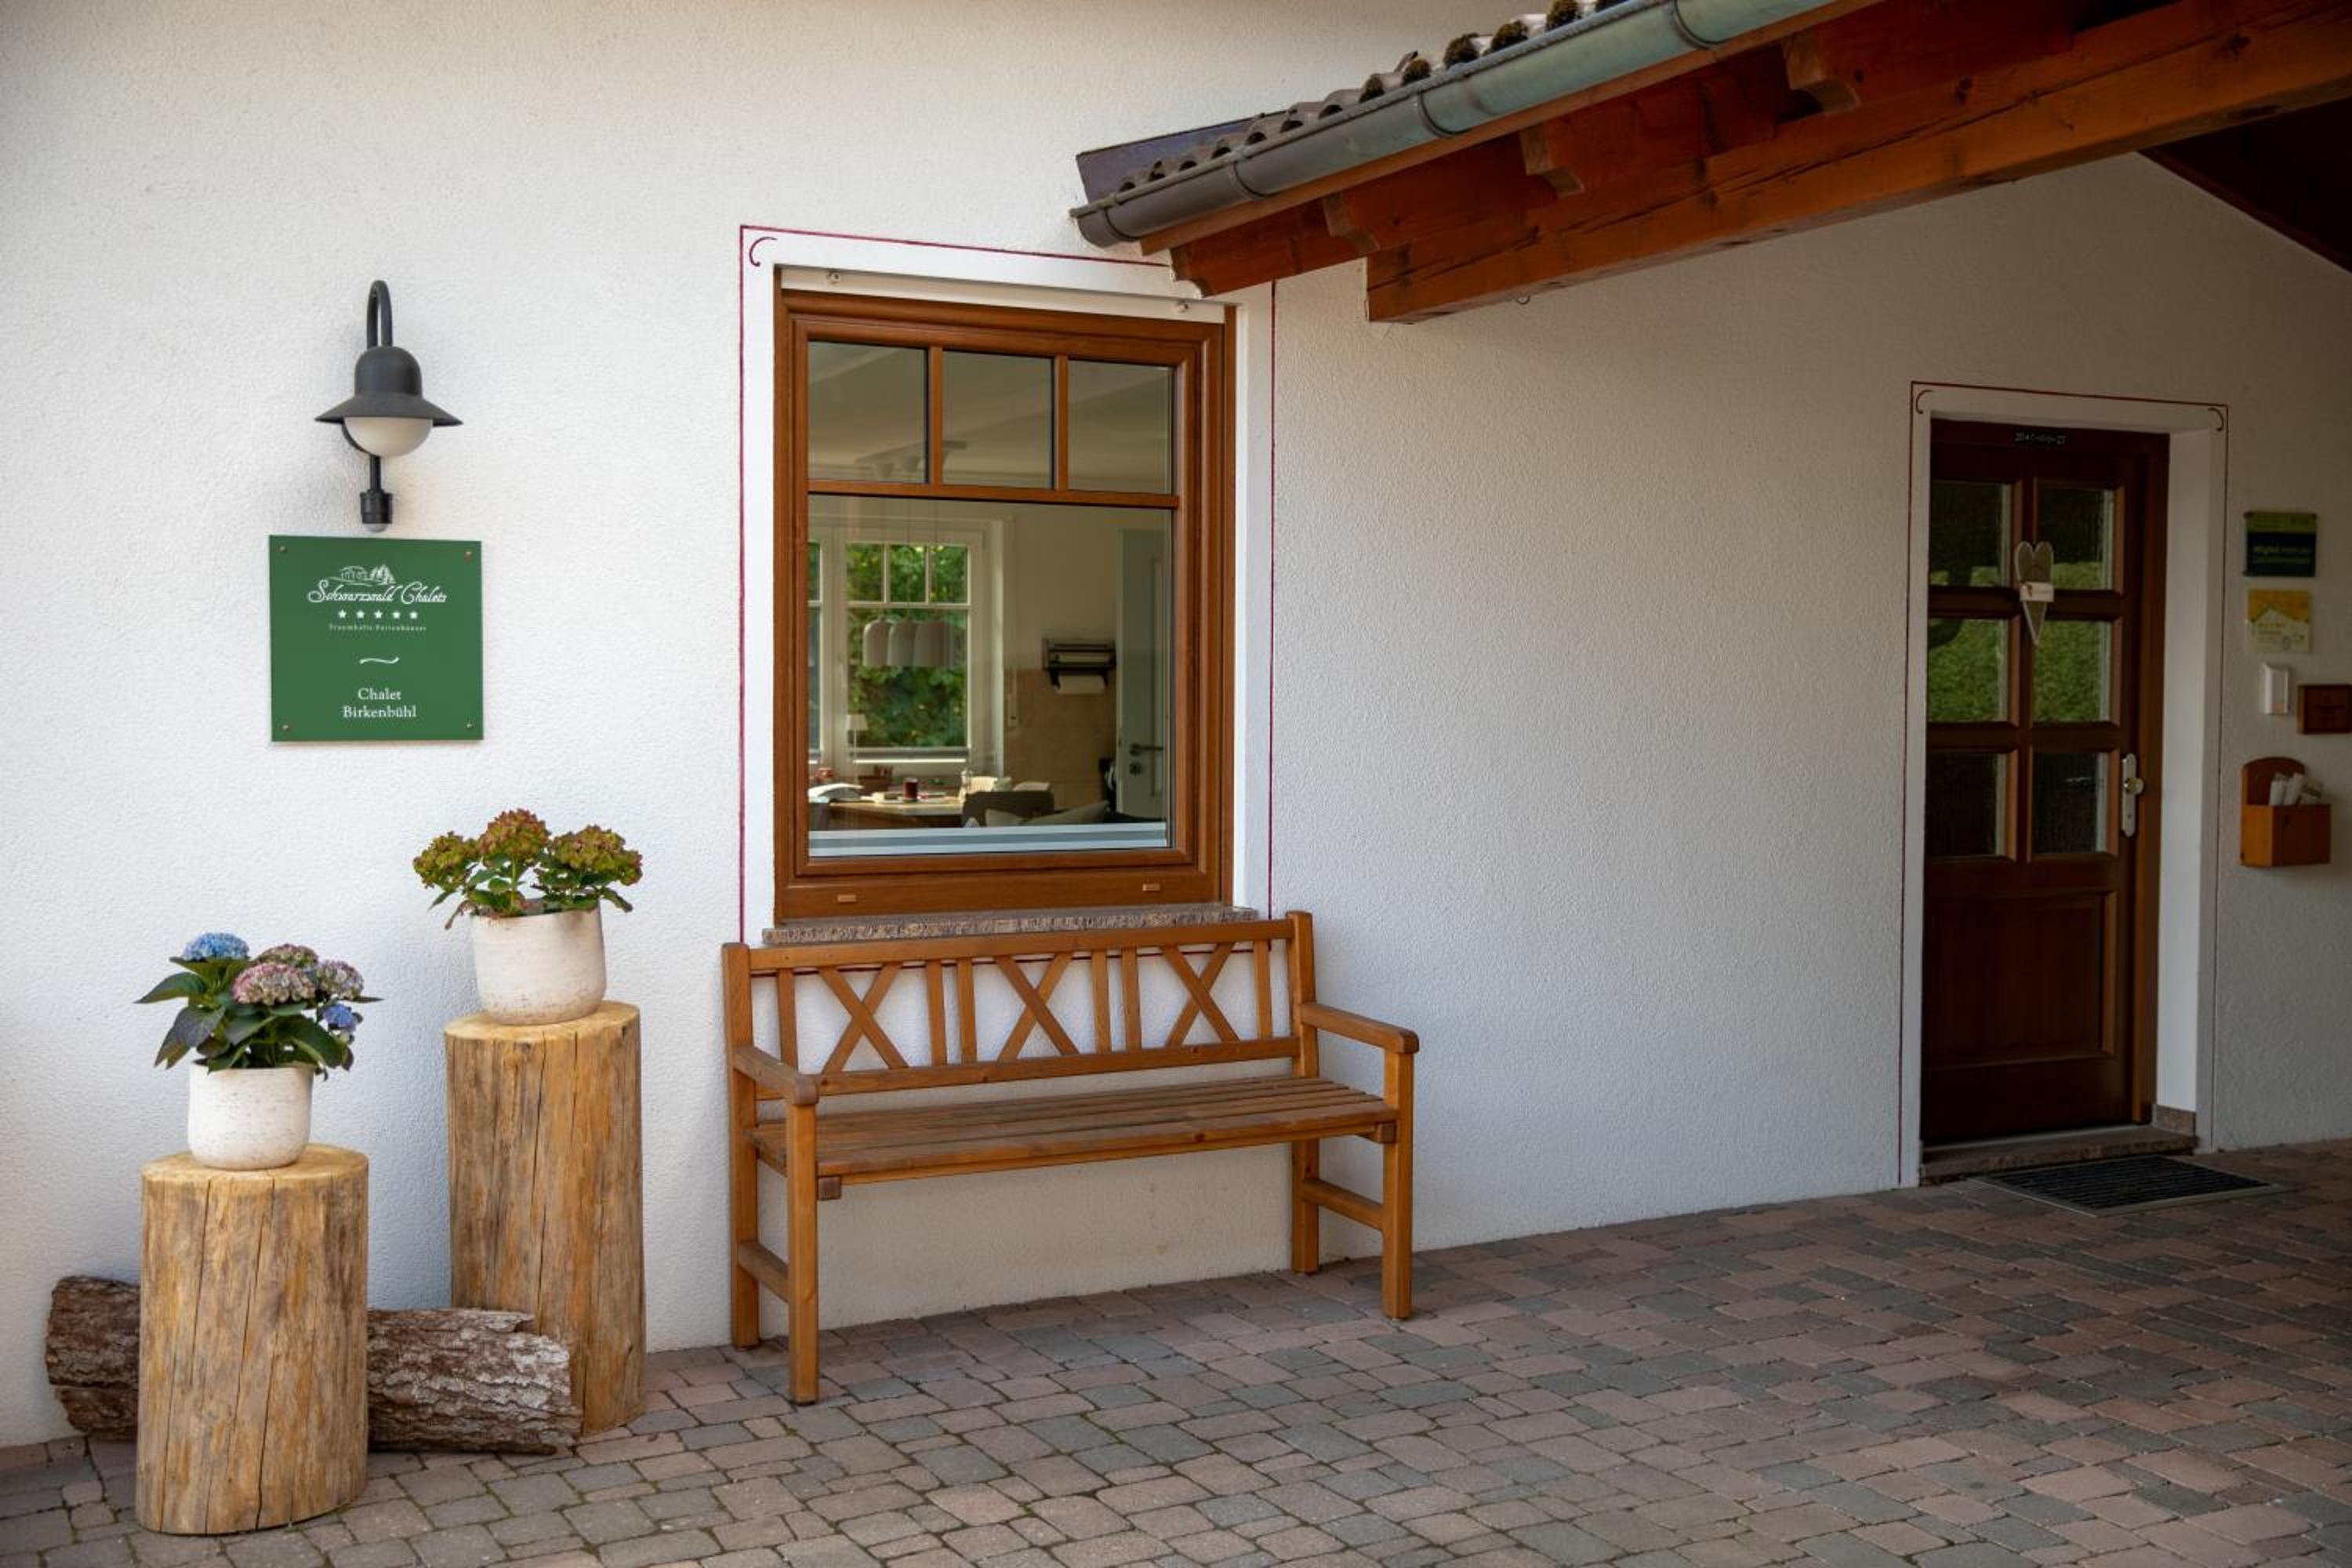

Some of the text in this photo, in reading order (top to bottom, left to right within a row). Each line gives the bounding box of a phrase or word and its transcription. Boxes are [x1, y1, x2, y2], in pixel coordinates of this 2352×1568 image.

[401, 581, 447, 604] Chalets
[358, 688, 402, 701] Chalet
[343, 705, 417, 719] Birkenbühl
